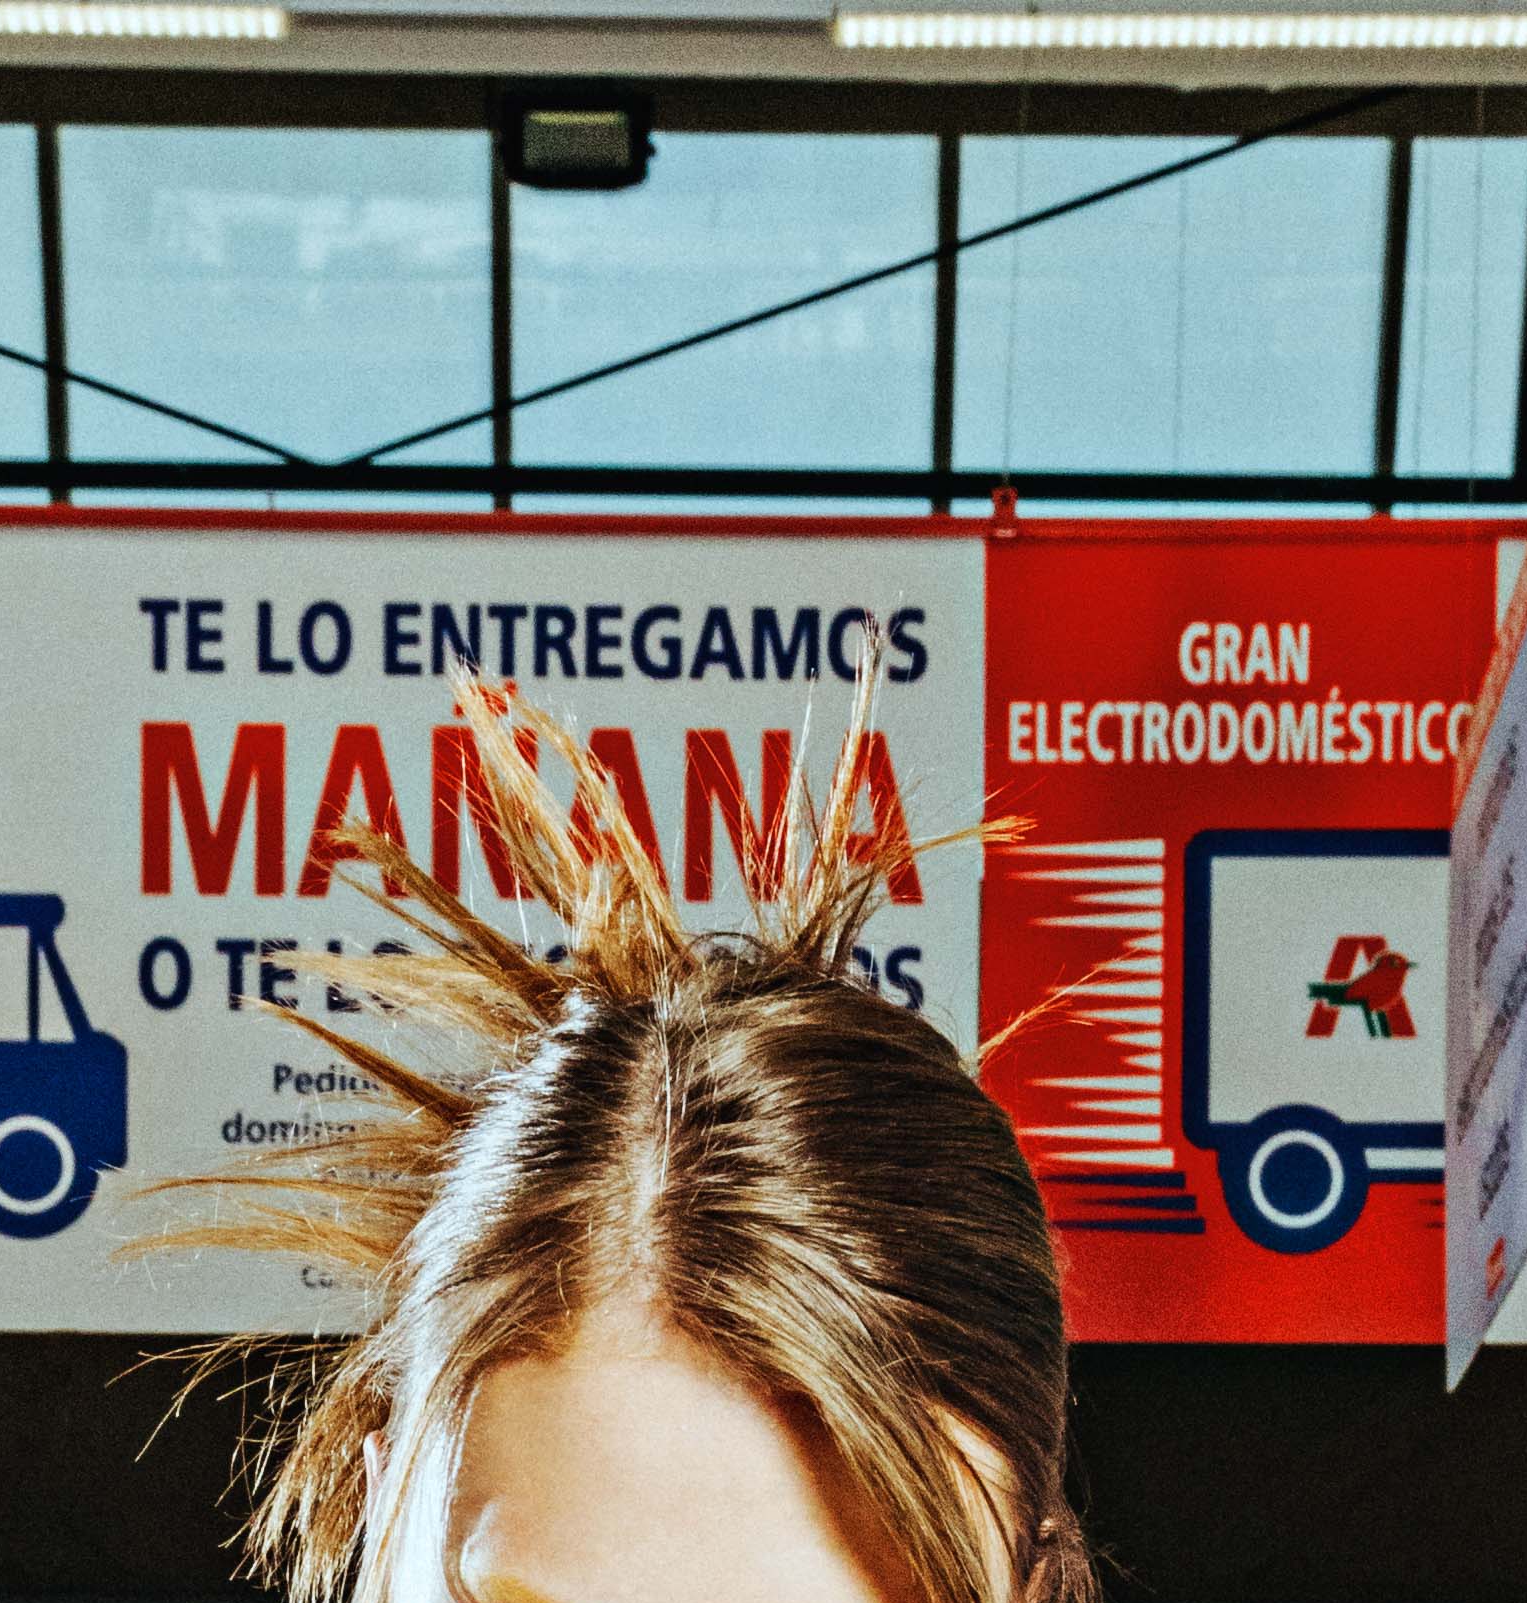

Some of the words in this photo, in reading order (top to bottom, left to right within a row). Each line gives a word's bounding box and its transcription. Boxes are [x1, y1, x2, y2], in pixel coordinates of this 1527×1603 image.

[139, 598, 224, 673] TE
[257, 600, 352, 676] LO
[383, 602, 929, 684] ENTREGAMOS
[1179, 622, 1311, 686] GRAN
[141, 681, 925, 905] MAÑANA
